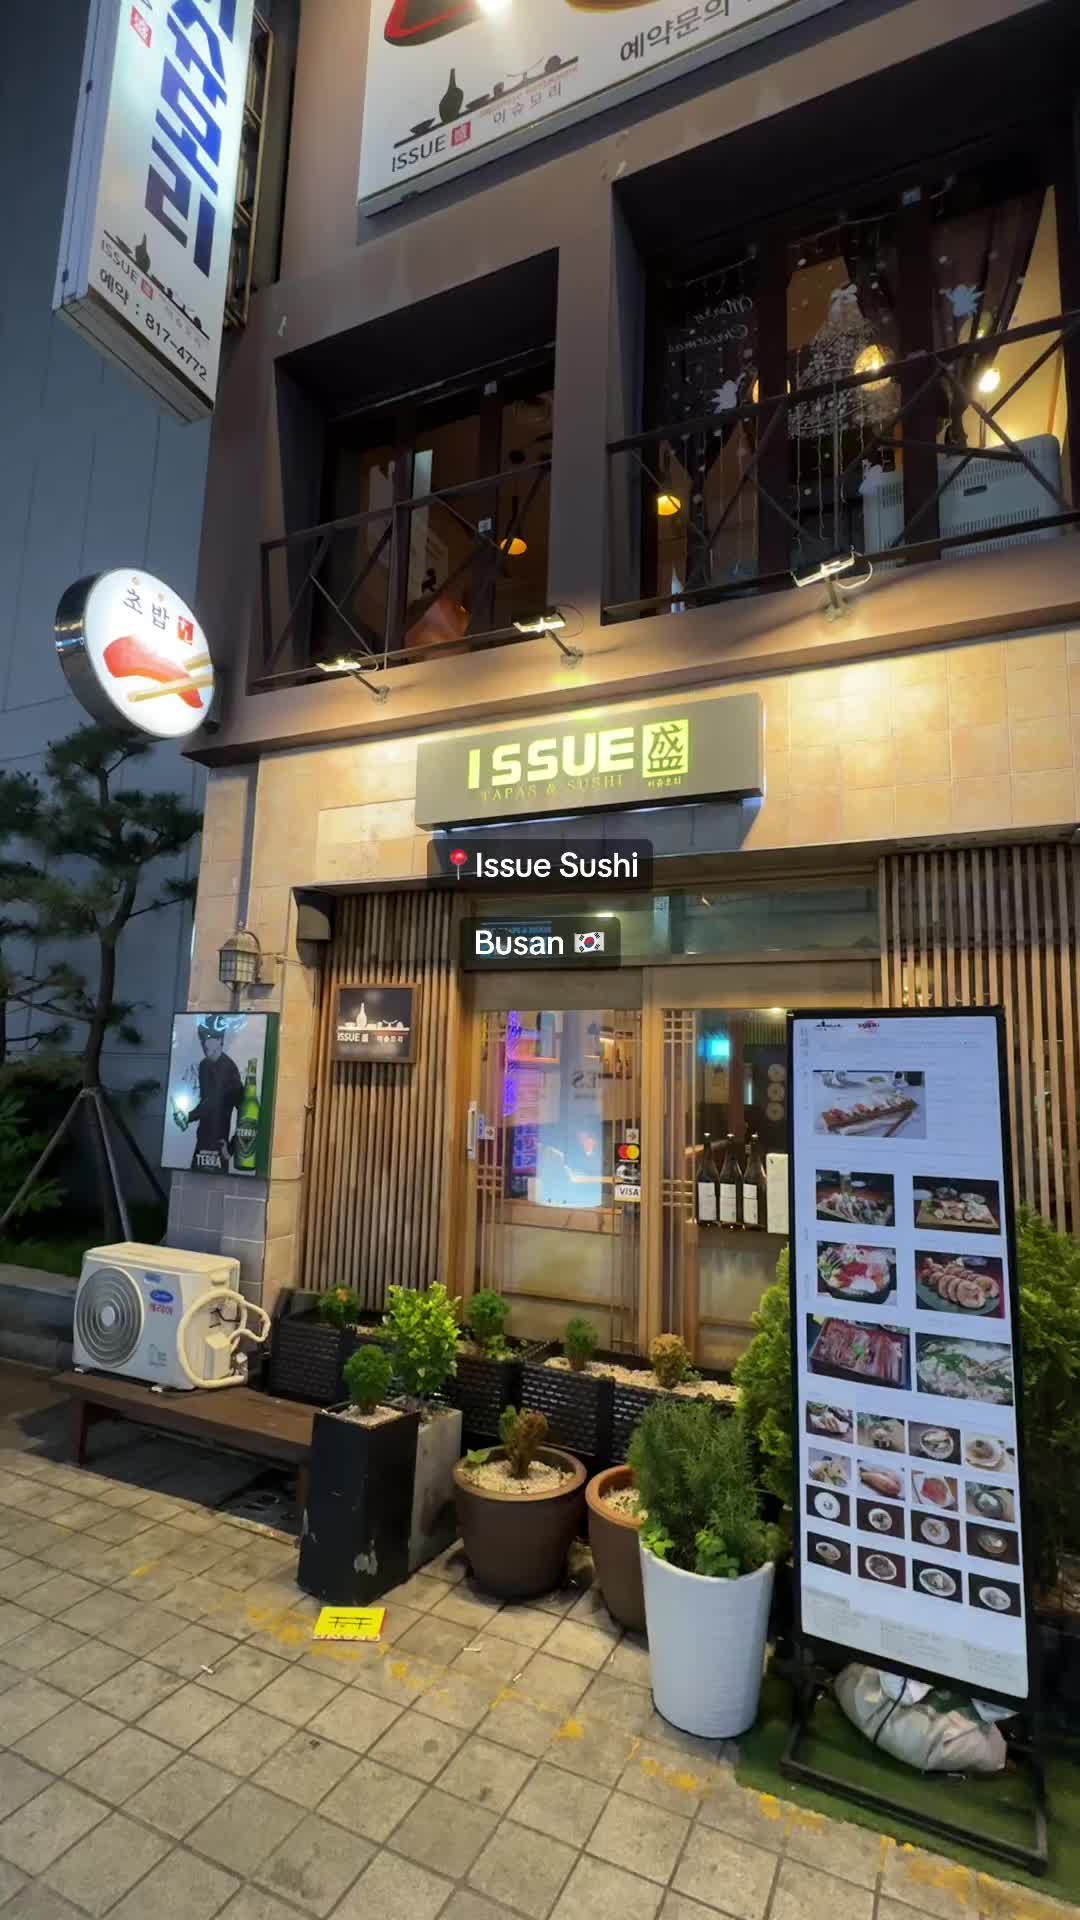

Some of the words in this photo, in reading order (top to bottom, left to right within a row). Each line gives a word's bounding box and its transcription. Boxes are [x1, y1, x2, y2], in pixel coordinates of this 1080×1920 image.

[620, 0, 729, 61] 예약문의
[391, 133, 447, 173] ISSUE
[101, 239, 139, 284] ISSUE
[100, 268, 129, 305] 예약
[145, 313, 208, 382] 817-4772
[123, 588, 171, 631] 초밥
[467, 727, 635, 790] ISSUE
[481, 784, 537, 802] TAPAS
[567, 775, 625, 792] SUSHI
[336, 1031, 361, 1042] ISSUE
[195, 1154, 222, 1168] TERRA
[619, 1187, 640, 1197] VISA
